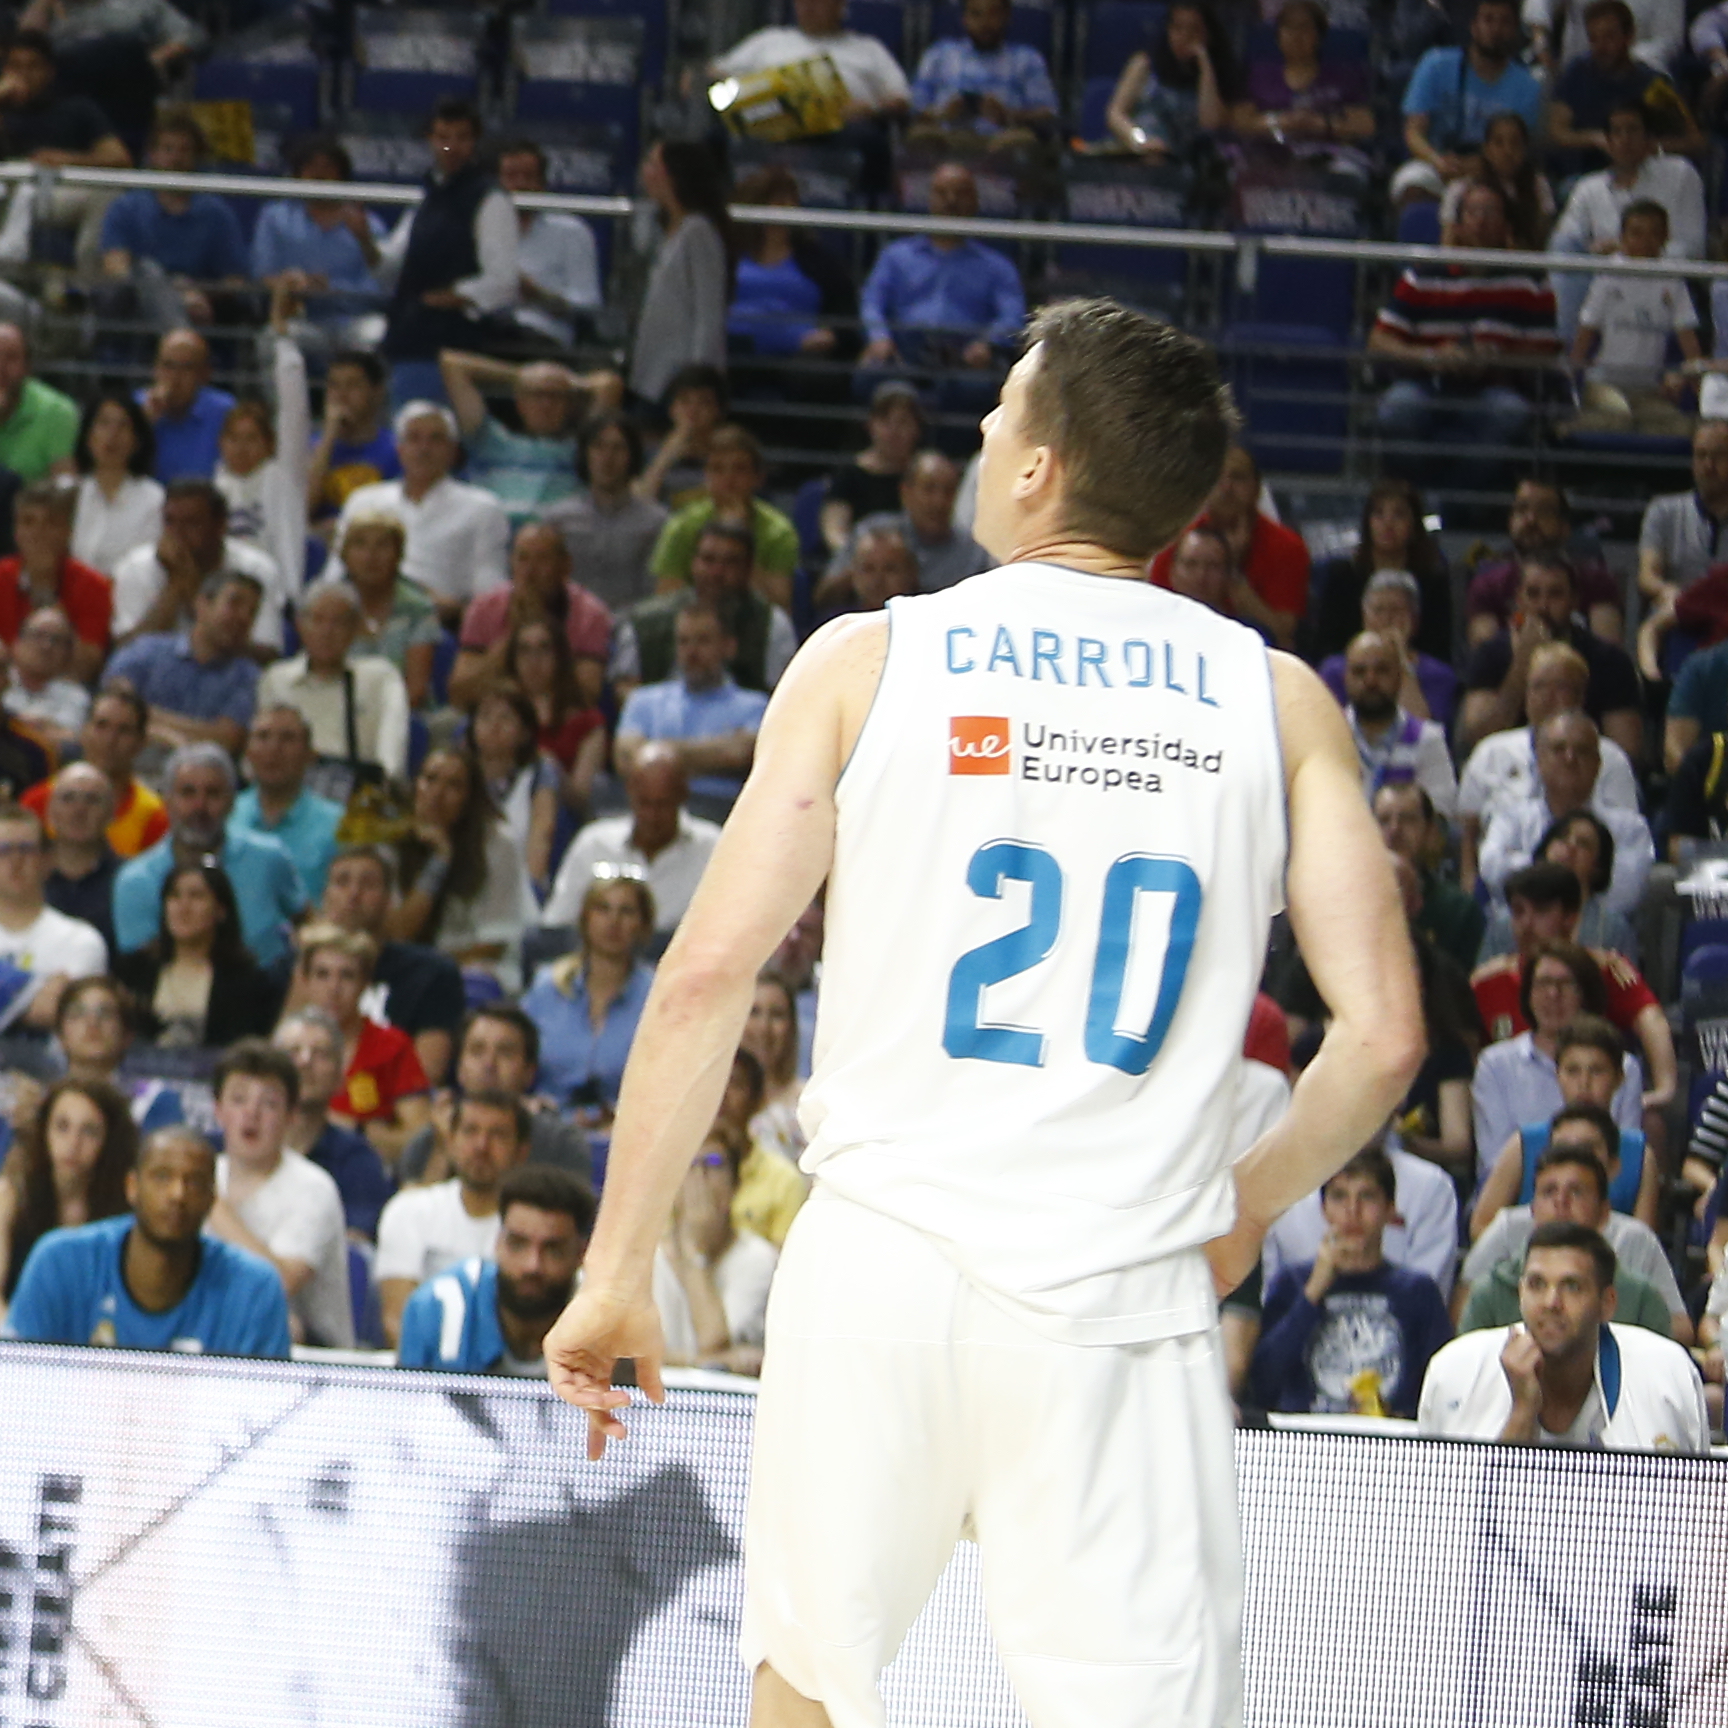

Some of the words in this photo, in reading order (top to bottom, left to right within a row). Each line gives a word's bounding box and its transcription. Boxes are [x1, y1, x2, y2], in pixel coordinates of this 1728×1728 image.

[946, 624, 1222, 708] CARROLL
[1020, 755, 1164, 793] Europea
[1022, 722, 1224, 774] Universidad
[940, 837, 1204, 1076] 20
